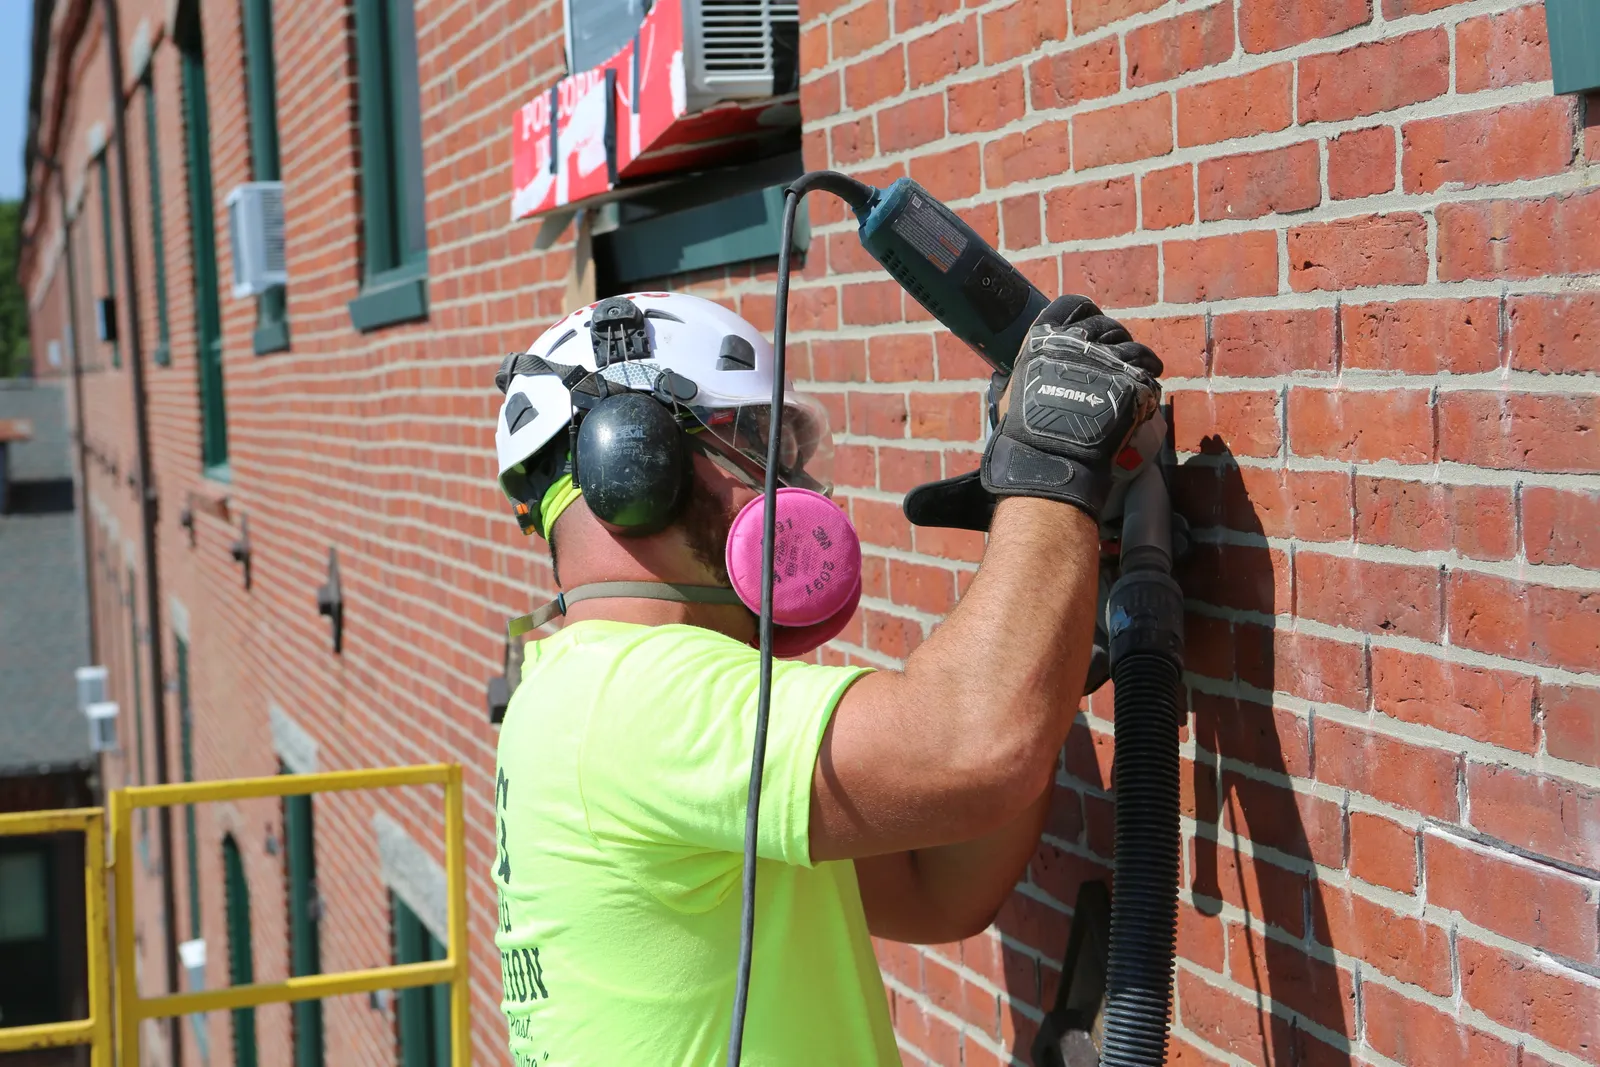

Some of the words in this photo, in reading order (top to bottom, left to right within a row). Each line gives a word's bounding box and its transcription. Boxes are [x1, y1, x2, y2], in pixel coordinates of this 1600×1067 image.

[1037, 384, 1087, 402] HUSKY
[613, 429, 647, 440] DEVIL
[812, 526, 833, 550] 3M
[805, 561, 835, 596] 2091
